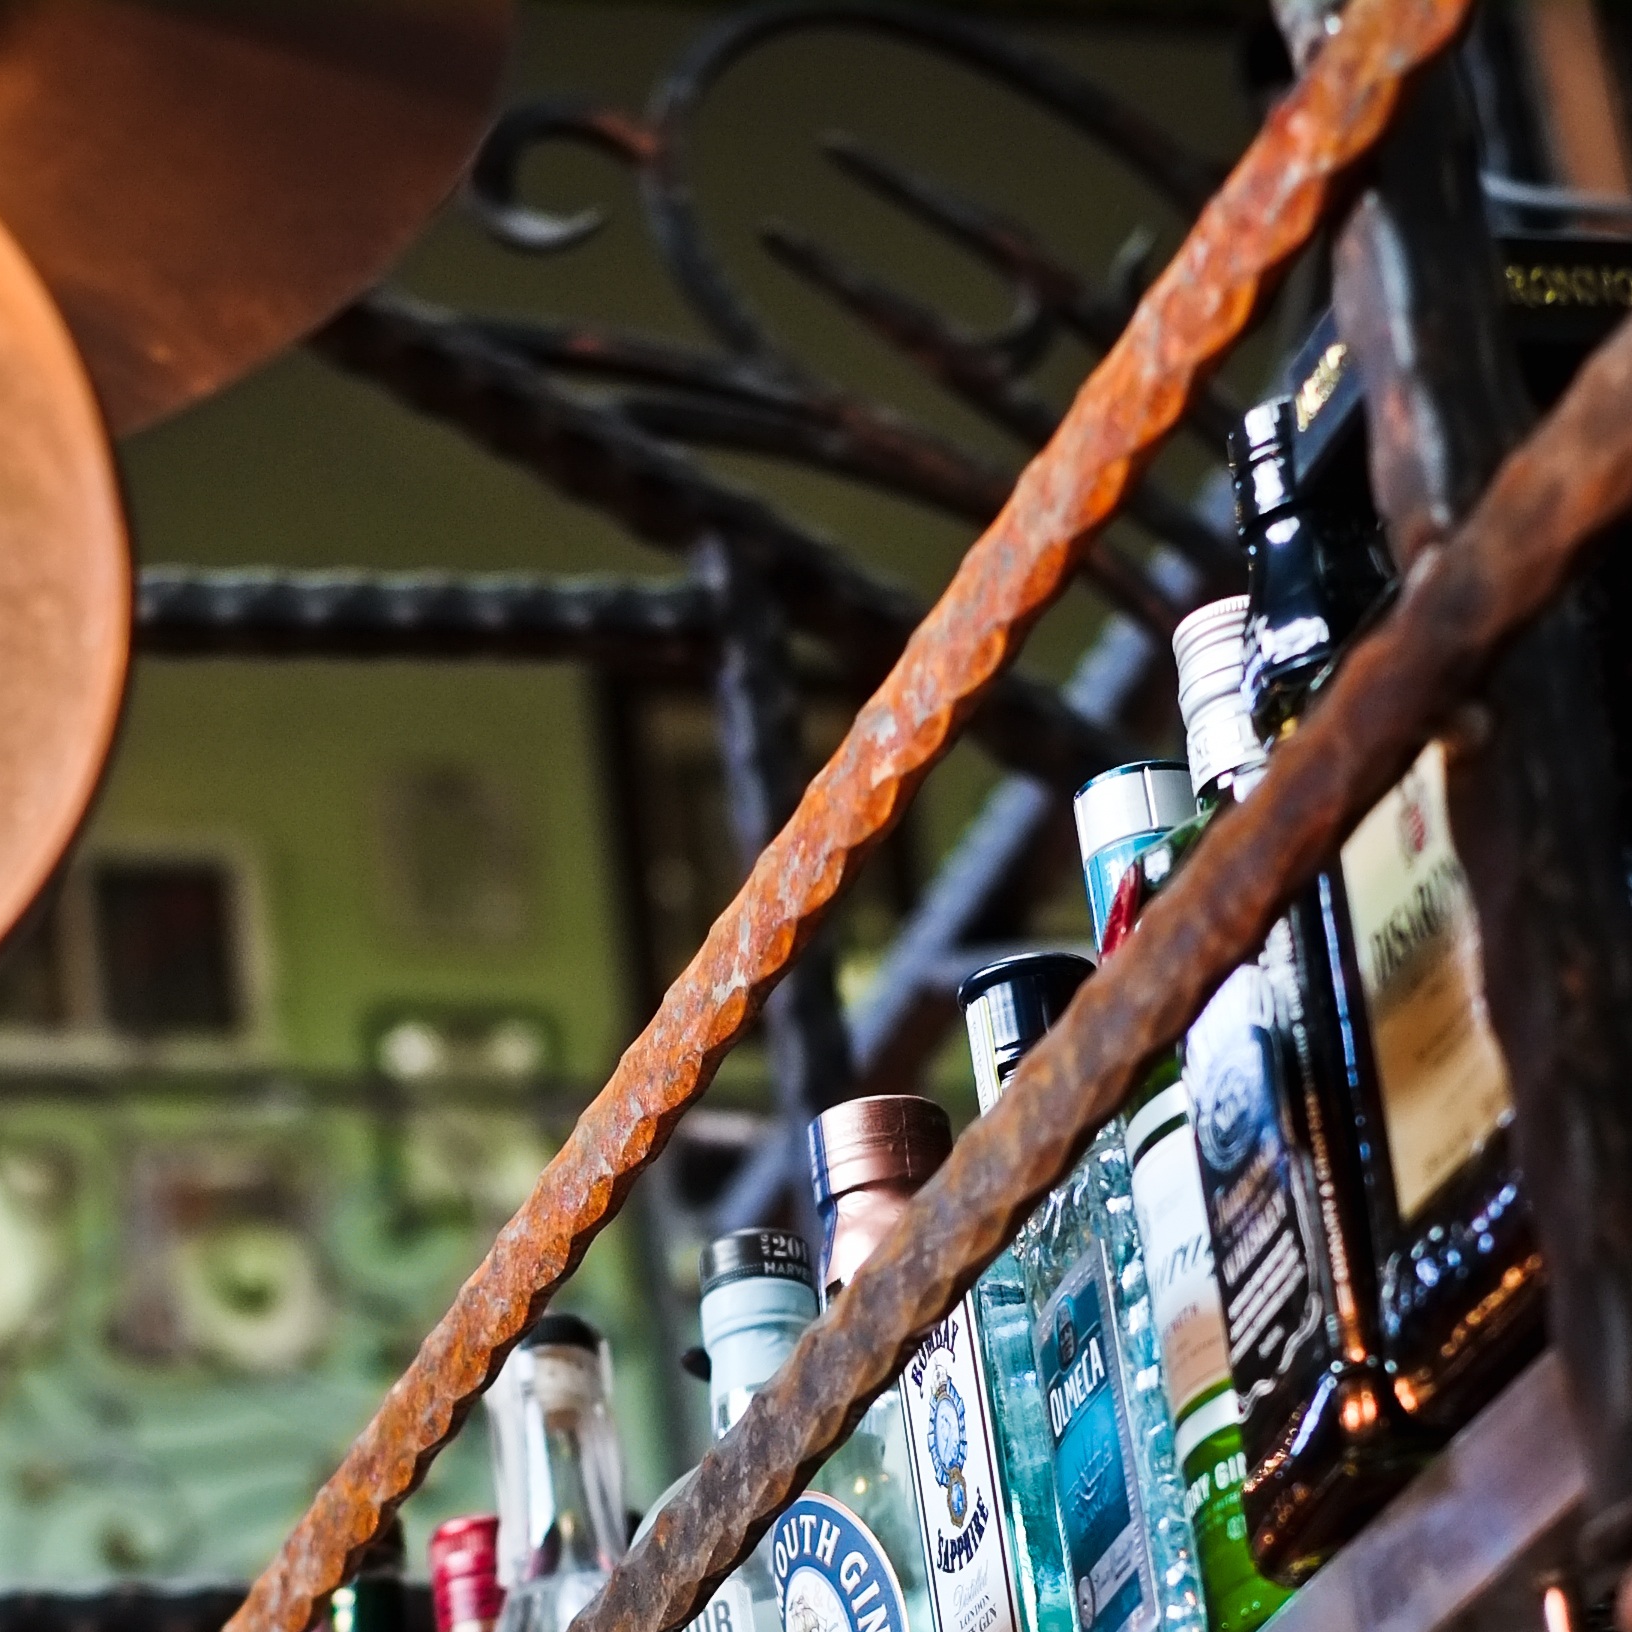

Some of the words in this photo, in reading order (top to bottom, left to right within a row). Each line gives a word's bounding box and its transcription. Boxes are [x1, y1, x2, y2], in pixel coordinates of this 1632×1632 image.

[911, 1319, 959, 1399] BOMBAY
[1049, 1336, 1106, 1438] OLMECA
[937, 1486, 989, 1574] SAPPHIRE
[959, 1594, 991, 1630] LONDON
[979, 1603, 998, 1632] GIN
